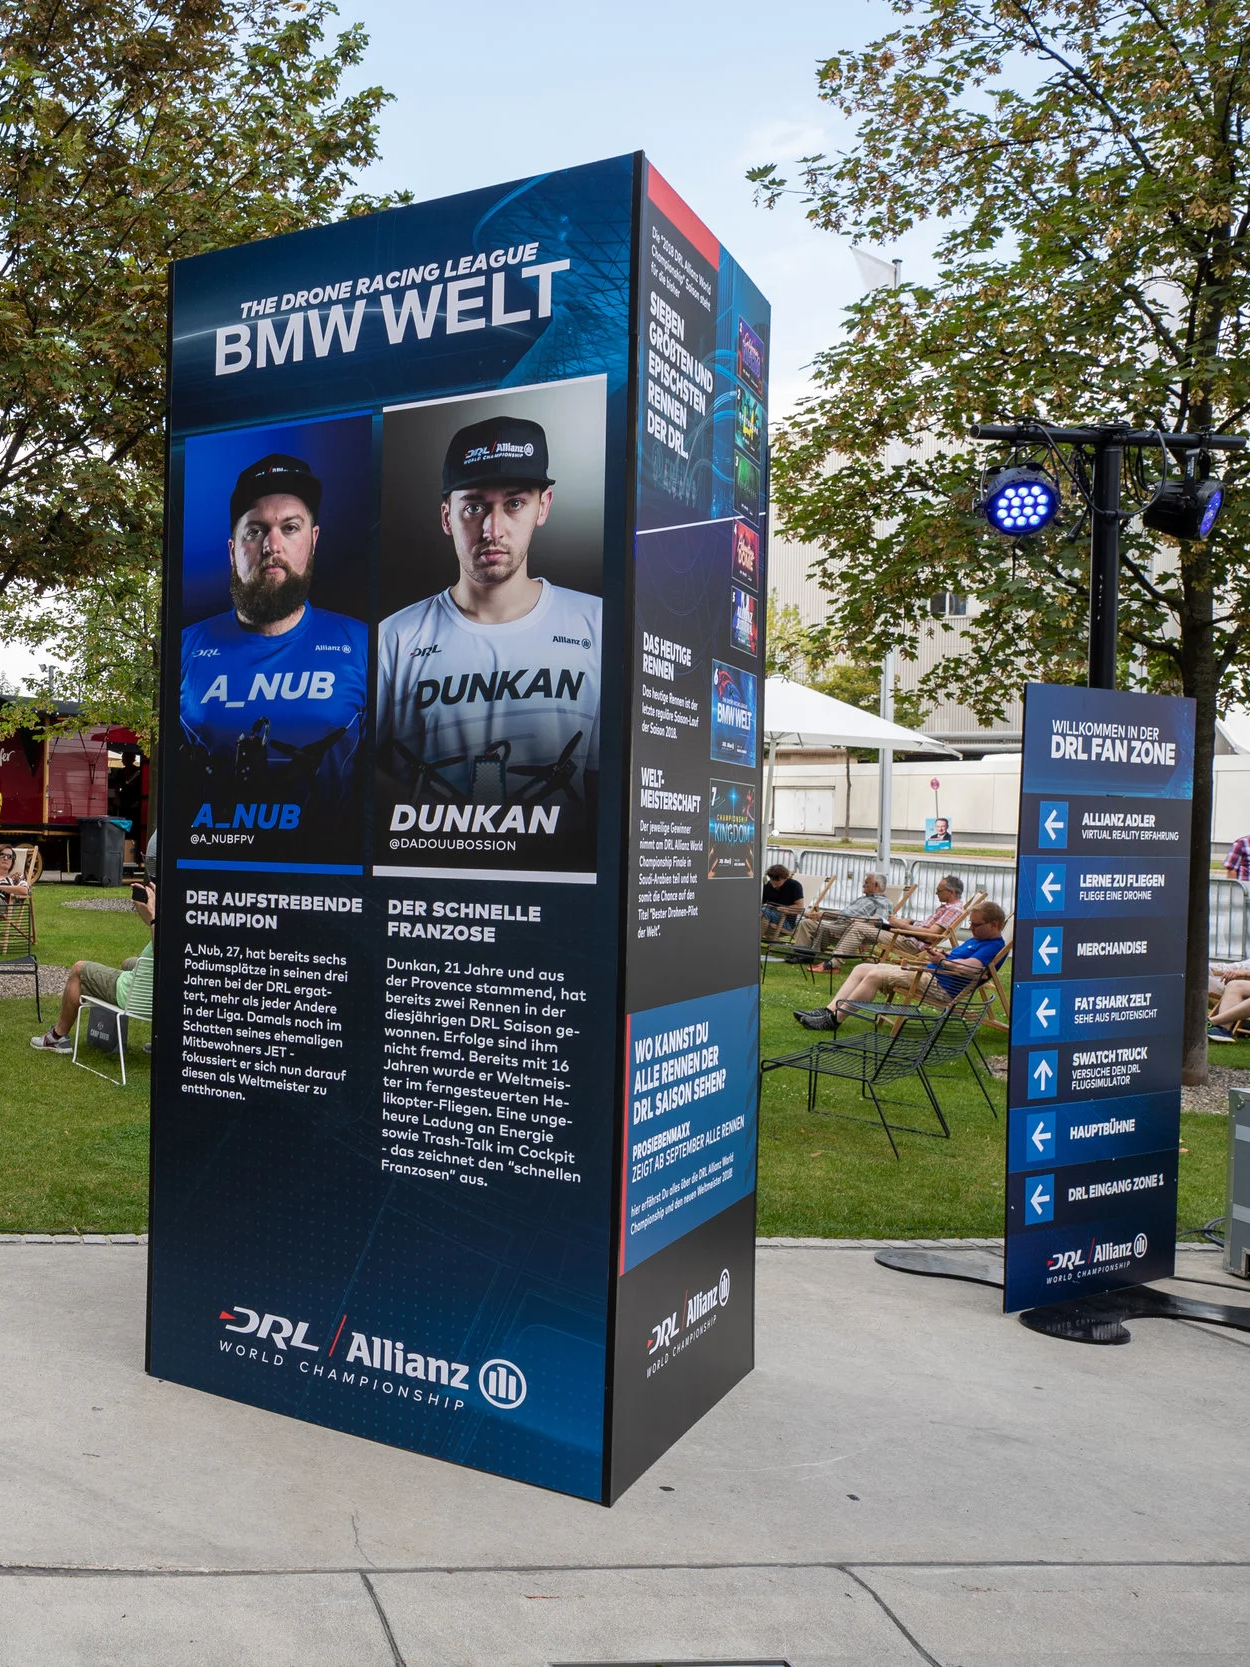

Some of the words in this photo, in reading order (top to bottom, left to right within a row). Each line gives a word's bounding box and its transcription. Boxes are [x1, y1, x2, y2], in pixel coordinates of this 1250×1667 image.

[240, 295, 278, 319] THE
[280, 280, 353, 311] DRONE
[355, 263, 440, 295] RACING
[443, 241, 539, 277] LEAGUE
[215, 298, 367, 376] BMW
[381, 258, 570, 345] WELT
[649, 291, 684, 341] SIEBEN
[648, 349, 705, 416] EPISCHSTEN
[694, 359, 713, 393] UND
[647, 378, 686, 429] RENNEN
[647, 408, 667, 444] DER
[667, 424, 688, 459] DRL.
[482, 453, 524, 461] CHAMPIONSHIP
[496, 443, 524, 453] Allianz
[315, 644, 341, 652] Allianz
[552, 635, 581, 646] Allianz
[643, 631, 659, 655] DAS
[660, 638, 691, 667] HEUTIGE
[642, 653, 674, 681] RENNEN
[713, 668, 719, 685] 6
[201, 671, 336, 708] A_NUB
[416, 668, 585, 710] DUNKAN
[642, 684, 651, 698] Das
[651, 687, 668, 705] heutige
[669, 692, 684, 707] Rennen
[690, 699, 698, 710] der
[717, 703, 735, 726] BMW
[736, 706, 752, 730] WELT
[1052, 719, 1125, 738] WILLKOMMEN
[1127, 725, 1138, 739] IN
[1139, 726, 1159, 740] DER
[1051, 735, 1088, 760] DRL
[1091, 737, 1128, 762] FAN
[1130, 740, 1176, 765] ZONE
[640, 766, 664, 788] WELT-
[640, 788, 701, 813] MEISTERSCHAFT
[711, 786, 717, 806] 7
[190, 803, 301, 829] A_NUB
[389, 804, 560, 834] DUNKAN
[639, 819, 649, 831] Der
[649, 820, 670, 835] jeweilige
[670, 821, 691, 834] Gewinner
[1082, 812, 1124, 826] ALLIANZ
[1124, 813, 1155, 827] ADLER
[190, 833, 254, 844] @A_NUBFPV
[389, 838, 515, 851] @DADOUUBOSSION
[714, 822, 750, 843] KINGDOM
[1081, 829, 1111, 839] VIRTUAL
[1112, 830, 1140, 839] REALITY
[1140, 830, 1179, 840] ERFAHRUNG
[1080, 874, 1112, 887] LERNE
[1112, 874, 1126, 887] ZU
[1127, 874, 1165, 887] FLIEGEN
[186, 890, 218, 905] DER
[221, 892, 362, 913] AUFSTREBENDE
[1079, 890, 1105, 900] FLIEGE
[1106, 890, 1122, 900] EINE
[1123, 890, 1152, 900] DROHNE
[185, 910, 277, 929] CHAMPION
[388, 899, 427, 916] DER
[432, 901, 541, 922] SCHNELLE
[387, 921, 495, 942] FRANZOSE
[184, 943, 223, 957] A_Nub,
[226, 945, 242, 959] 27,
[246, 947, 265, 959] hat
[269, 948, 309, 962] bereits
[312, 953, 346, 965] sechs
[1077, 940, 1147, 956] MERCHANDISE
[184, 958, 266, 975] Podiumsplätze
[269, 964, 279, 976] in
[283, 967, 320, 980] seinen
[324, 969, 347, 982] drei
[386, 957, 439, 974] Dunkan,
[444, 961, 460, 974] 21
[464, 963, 503, 977] Jahre
[508, 967, 534, 979] und
[538, 971, 564, 981] aus
[385, 974, 407, 986] der
[411, 976, 472, 992] Provence
[476, 982, 556, 1001] stammend,
[561, 987, 586, 1001] hat
[385, 990, 430, 1006] bereits
[434, 997, 464, 1009] zwei
[469, 998, 520, 1014] Rennen
[525, 1002, 537, 1015] in
[541, 1004, 566, 1017] der
[1074, 996, 1095, 1010] FAT
[1095, 994, 1129, 1009] SHARK
[1129, 993, 1151, 1007] ZELT
[1074, 1013, 1093, 1024] SEHE
[1094, 1012, 1109, 1022] AUS
[1110, 1008, 1157, 1021] PILOTENSICHT
[635, 1037, 653, 1064] WO
[654, 1024, 695, 1058] KANNST
[695, 1021, 708, 1045] DU
[1072, 1049, 1116, 1066] SWATCH
[1116, 1046, 1148, 1061] TRUCK
[633, 1063, 660, 1095] ALLE
[661, 1050, 700, 1084] RENNEN
[701, 1045, 719, 1070] DER
[1071, 1066, 1110, 1079] VERSUCHE
[1111, 1065, 1126, 1075] DEN
[1127, 1063, 1141, 1074] DRL
[1071, 1075, 1130, 1090] FLUGSIMULATOR
[633, 1096, 653, 1125] DRL
[655, 1080, 692, 1115] SAISON
[693, 1069, 726, 1100] SEHEN?
[1069, 1118, 1135, 1139] HAUPTBÜHNE
[631, 1157, 653, 1183] ZEIGT
[653, 1152, 664, 1171] AB
[665, 1133, 704, 1165] SEPTEMBER
[705, 1125, 720, 1146] ALLE
[721, 1114, 744, 1138] RENNEN
[632, 1120, 690, 1162] PROSIEBENMAXX
[1068, 1186, 1088, 1201] DRL
[1089, 1178, 1132, 1198] EINGANG
[1132, 1174, 1157, 1190] ZONE
[1158, 1173, 1164, 1185] 1
[630, 1206, 664, 1235] Championship
[665, 1200, 674, 1215] und
[674, 1197, 683, 1209] den
[683, 1190, 696, 1204] neuen
[697, 1175, 721, 1196] Weltmeister
[1047, 1249, 1085, 1270] DRL
[1093, 1242, 1132, 1263] Allianz
[1046, 1272, 1072, 1284] WORLD
[1076, 1260, 1130, 1278] CHAMPIONSHIP
[647, 1311, 680, 1355] DRL
[686, 1285, 718, 1328] Allianz
[220, 1306, 319, 1351] DRL
[346, 1330, 469, 1390] Allianz
[646, 1352, 668, 1378] WORLD
[672, 1314, 716, 1357] CHAMPIONSHIP
[219, 1340, 283, 1365] WORLD
[299, 1361, 464, 1410] CHAMPIONSHIP
